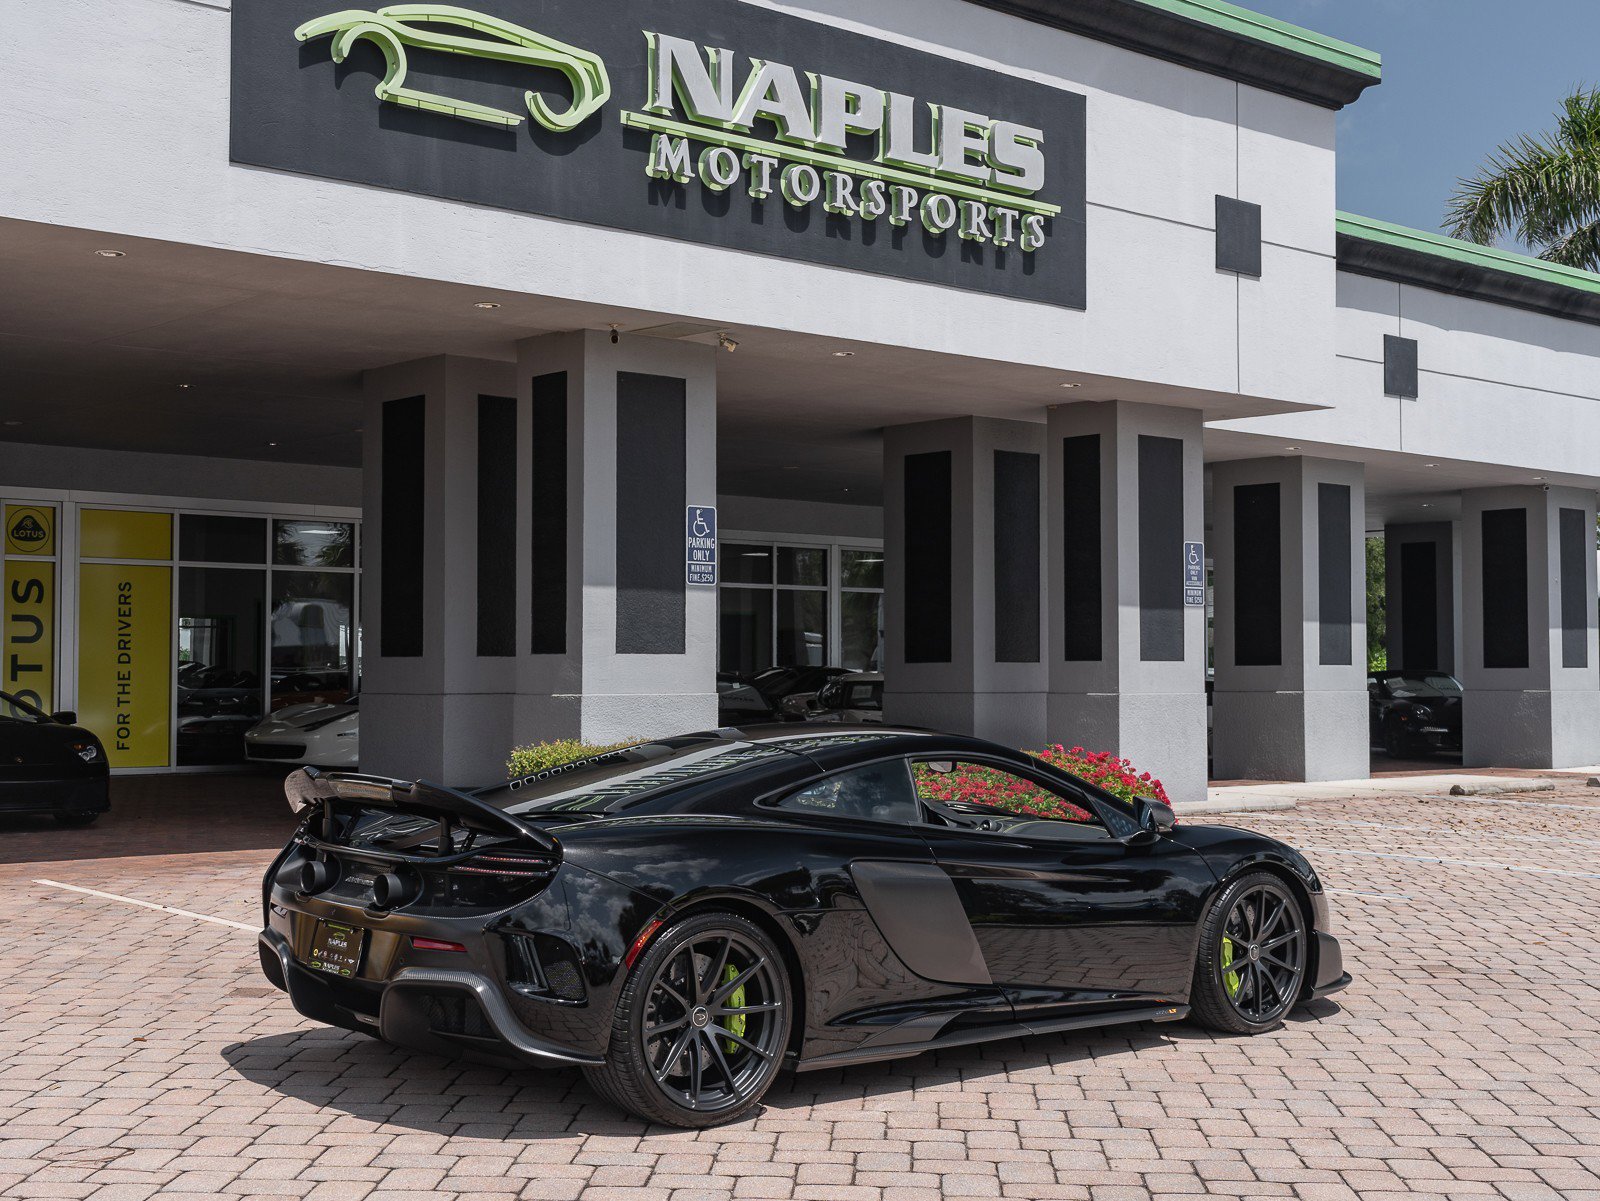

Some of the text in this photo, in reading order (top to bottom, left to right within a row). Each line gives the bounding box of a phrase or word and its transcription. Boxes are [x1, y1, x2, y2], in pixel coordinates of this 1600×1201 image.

[642, 30, 1045, 195] NAPLES
[645, 133, 1046, 251] MOTORSPORTS
[13, 529, 45, 538] LOTUS
[688, 537, 715, 549] PARKING
[693, 550, 710, 561] ONLY
[690, 564, 713, 573] MINIMUM
[690, 573, 714, 583] FINE $250
[9, 577, 44, 722] OTUS
[116, 581, 132, 750] FOR THE DRIVERS
